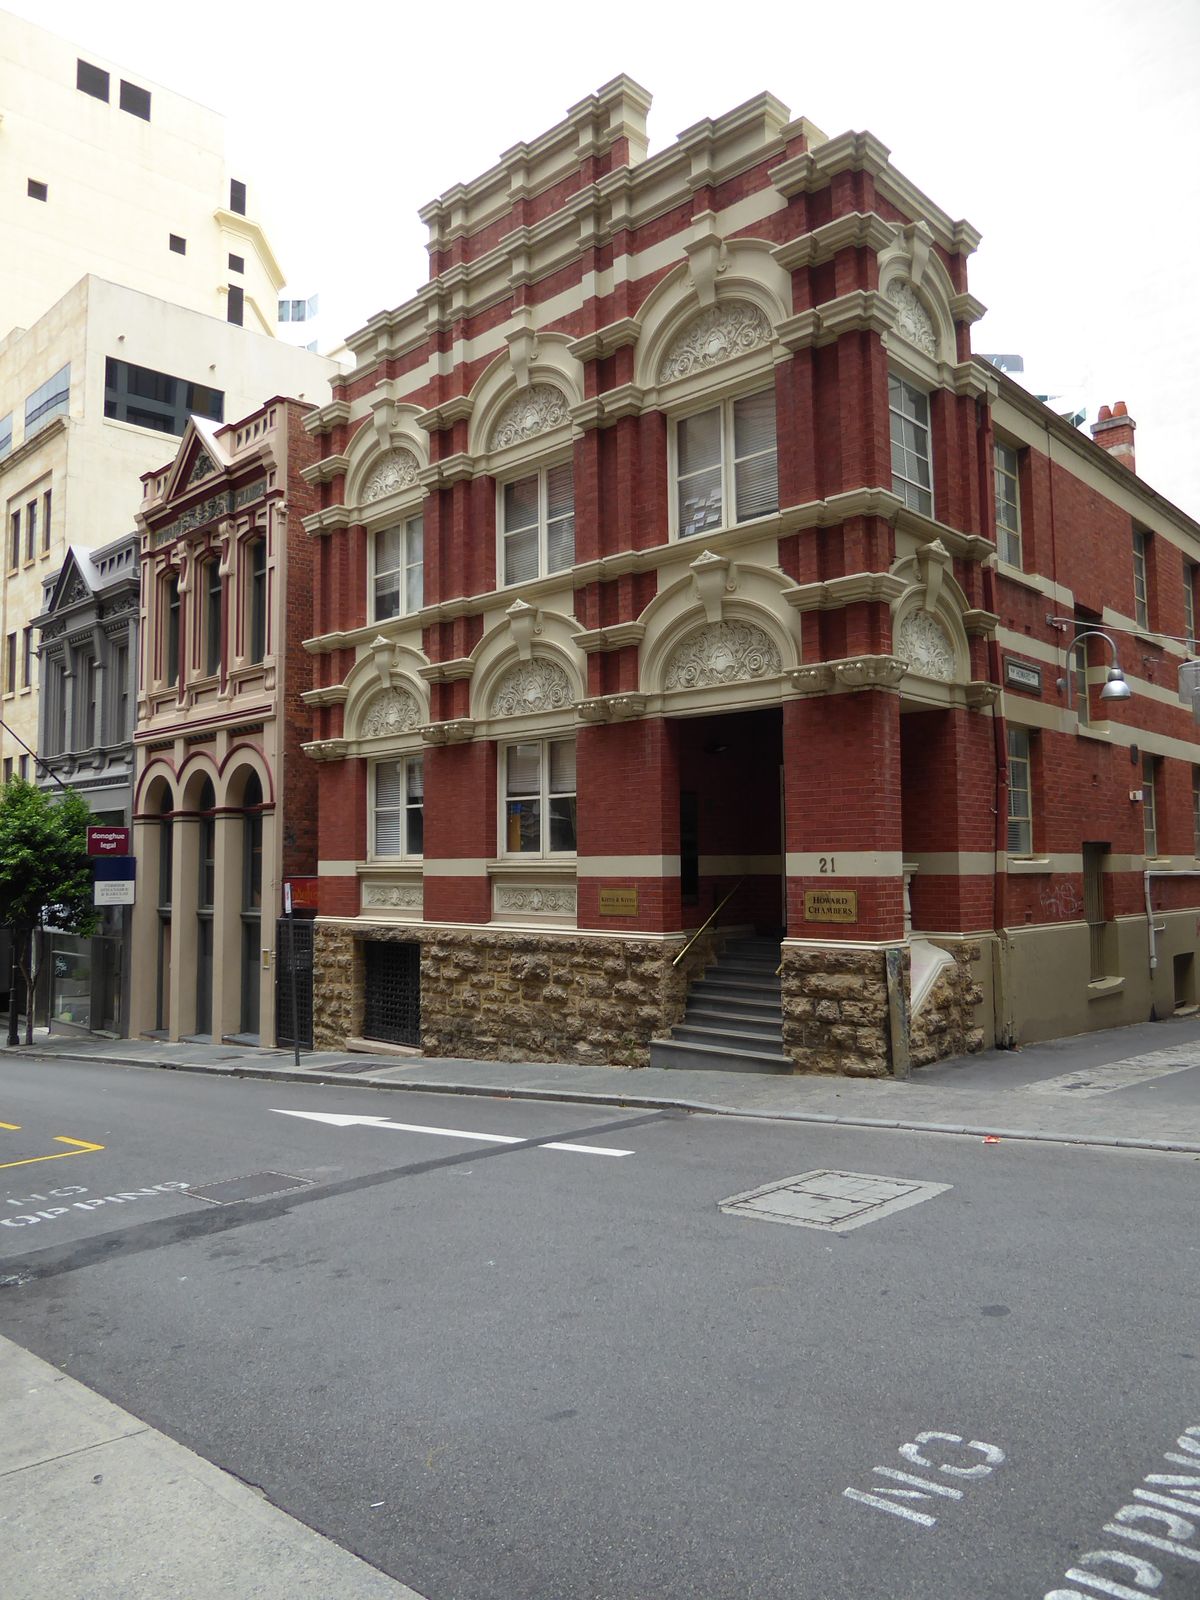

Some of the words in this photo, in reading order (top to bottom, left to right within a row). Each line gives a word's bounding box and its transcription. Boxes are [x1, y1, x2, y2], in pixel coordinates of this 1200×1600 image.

[91, 832, 125, 840] donoghue
[819, 857, 836, 873] 21
[812, 896, 848, 905] HOWARD
[808, 905, 853, 915] CHAMBERS
[6, 1185, 89, 1206] NO
[842, 1431, 1005, 1528] NO
